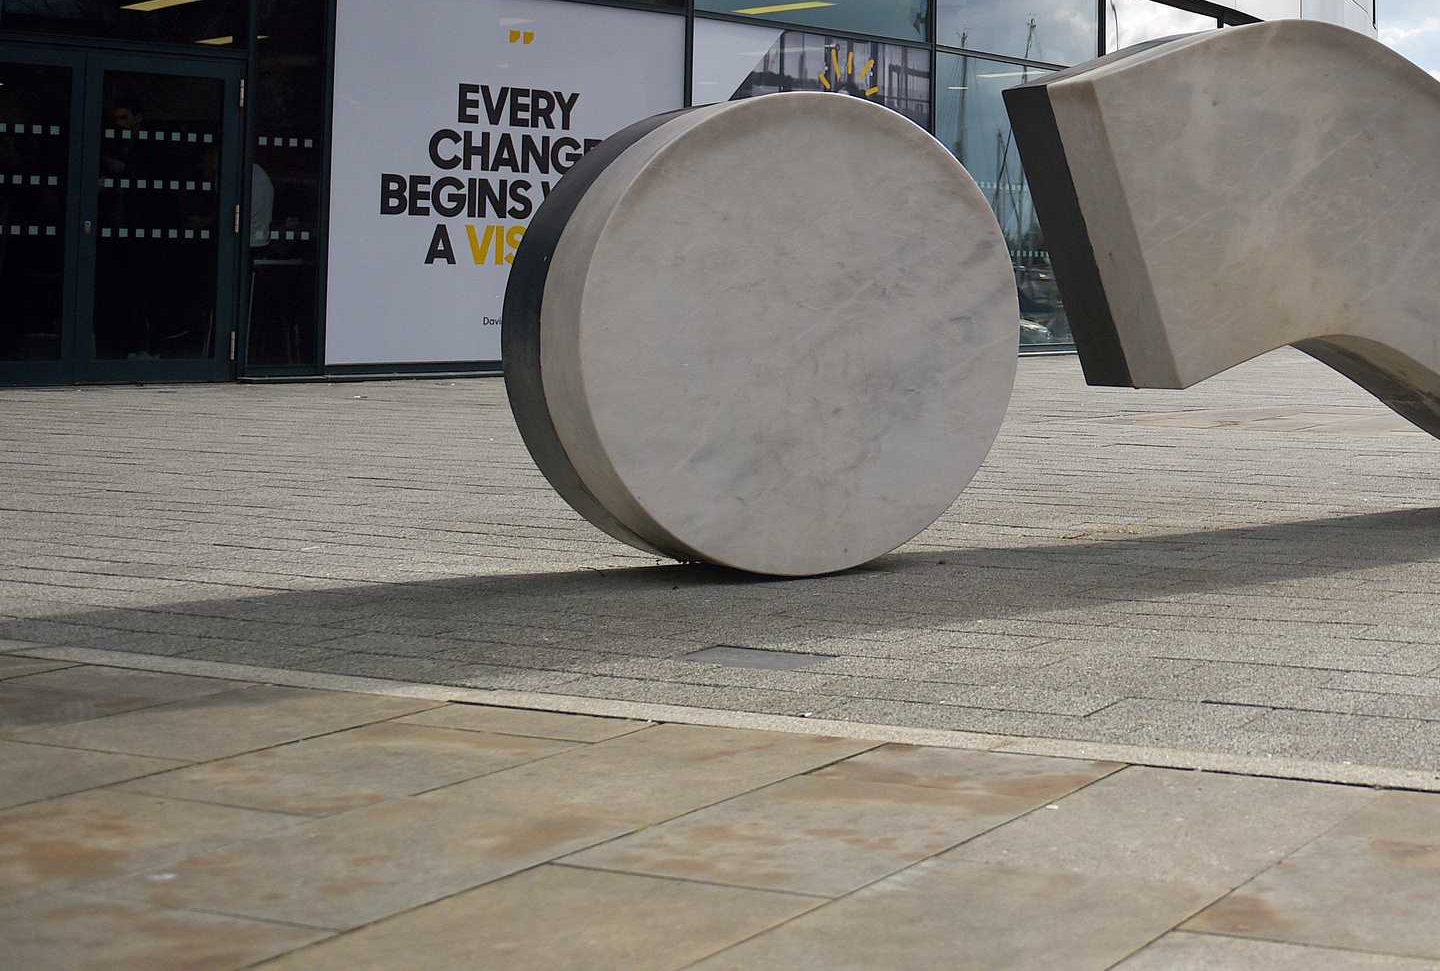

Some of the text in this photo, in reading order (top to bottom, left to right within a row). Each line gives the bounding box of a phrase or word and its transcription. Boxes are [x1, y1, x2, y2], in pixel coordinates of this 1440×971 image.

[457, 83, 580, 130] EVERY
[380, 174, 533, 219] BEGINS
[424, 224, 457, 265] A
